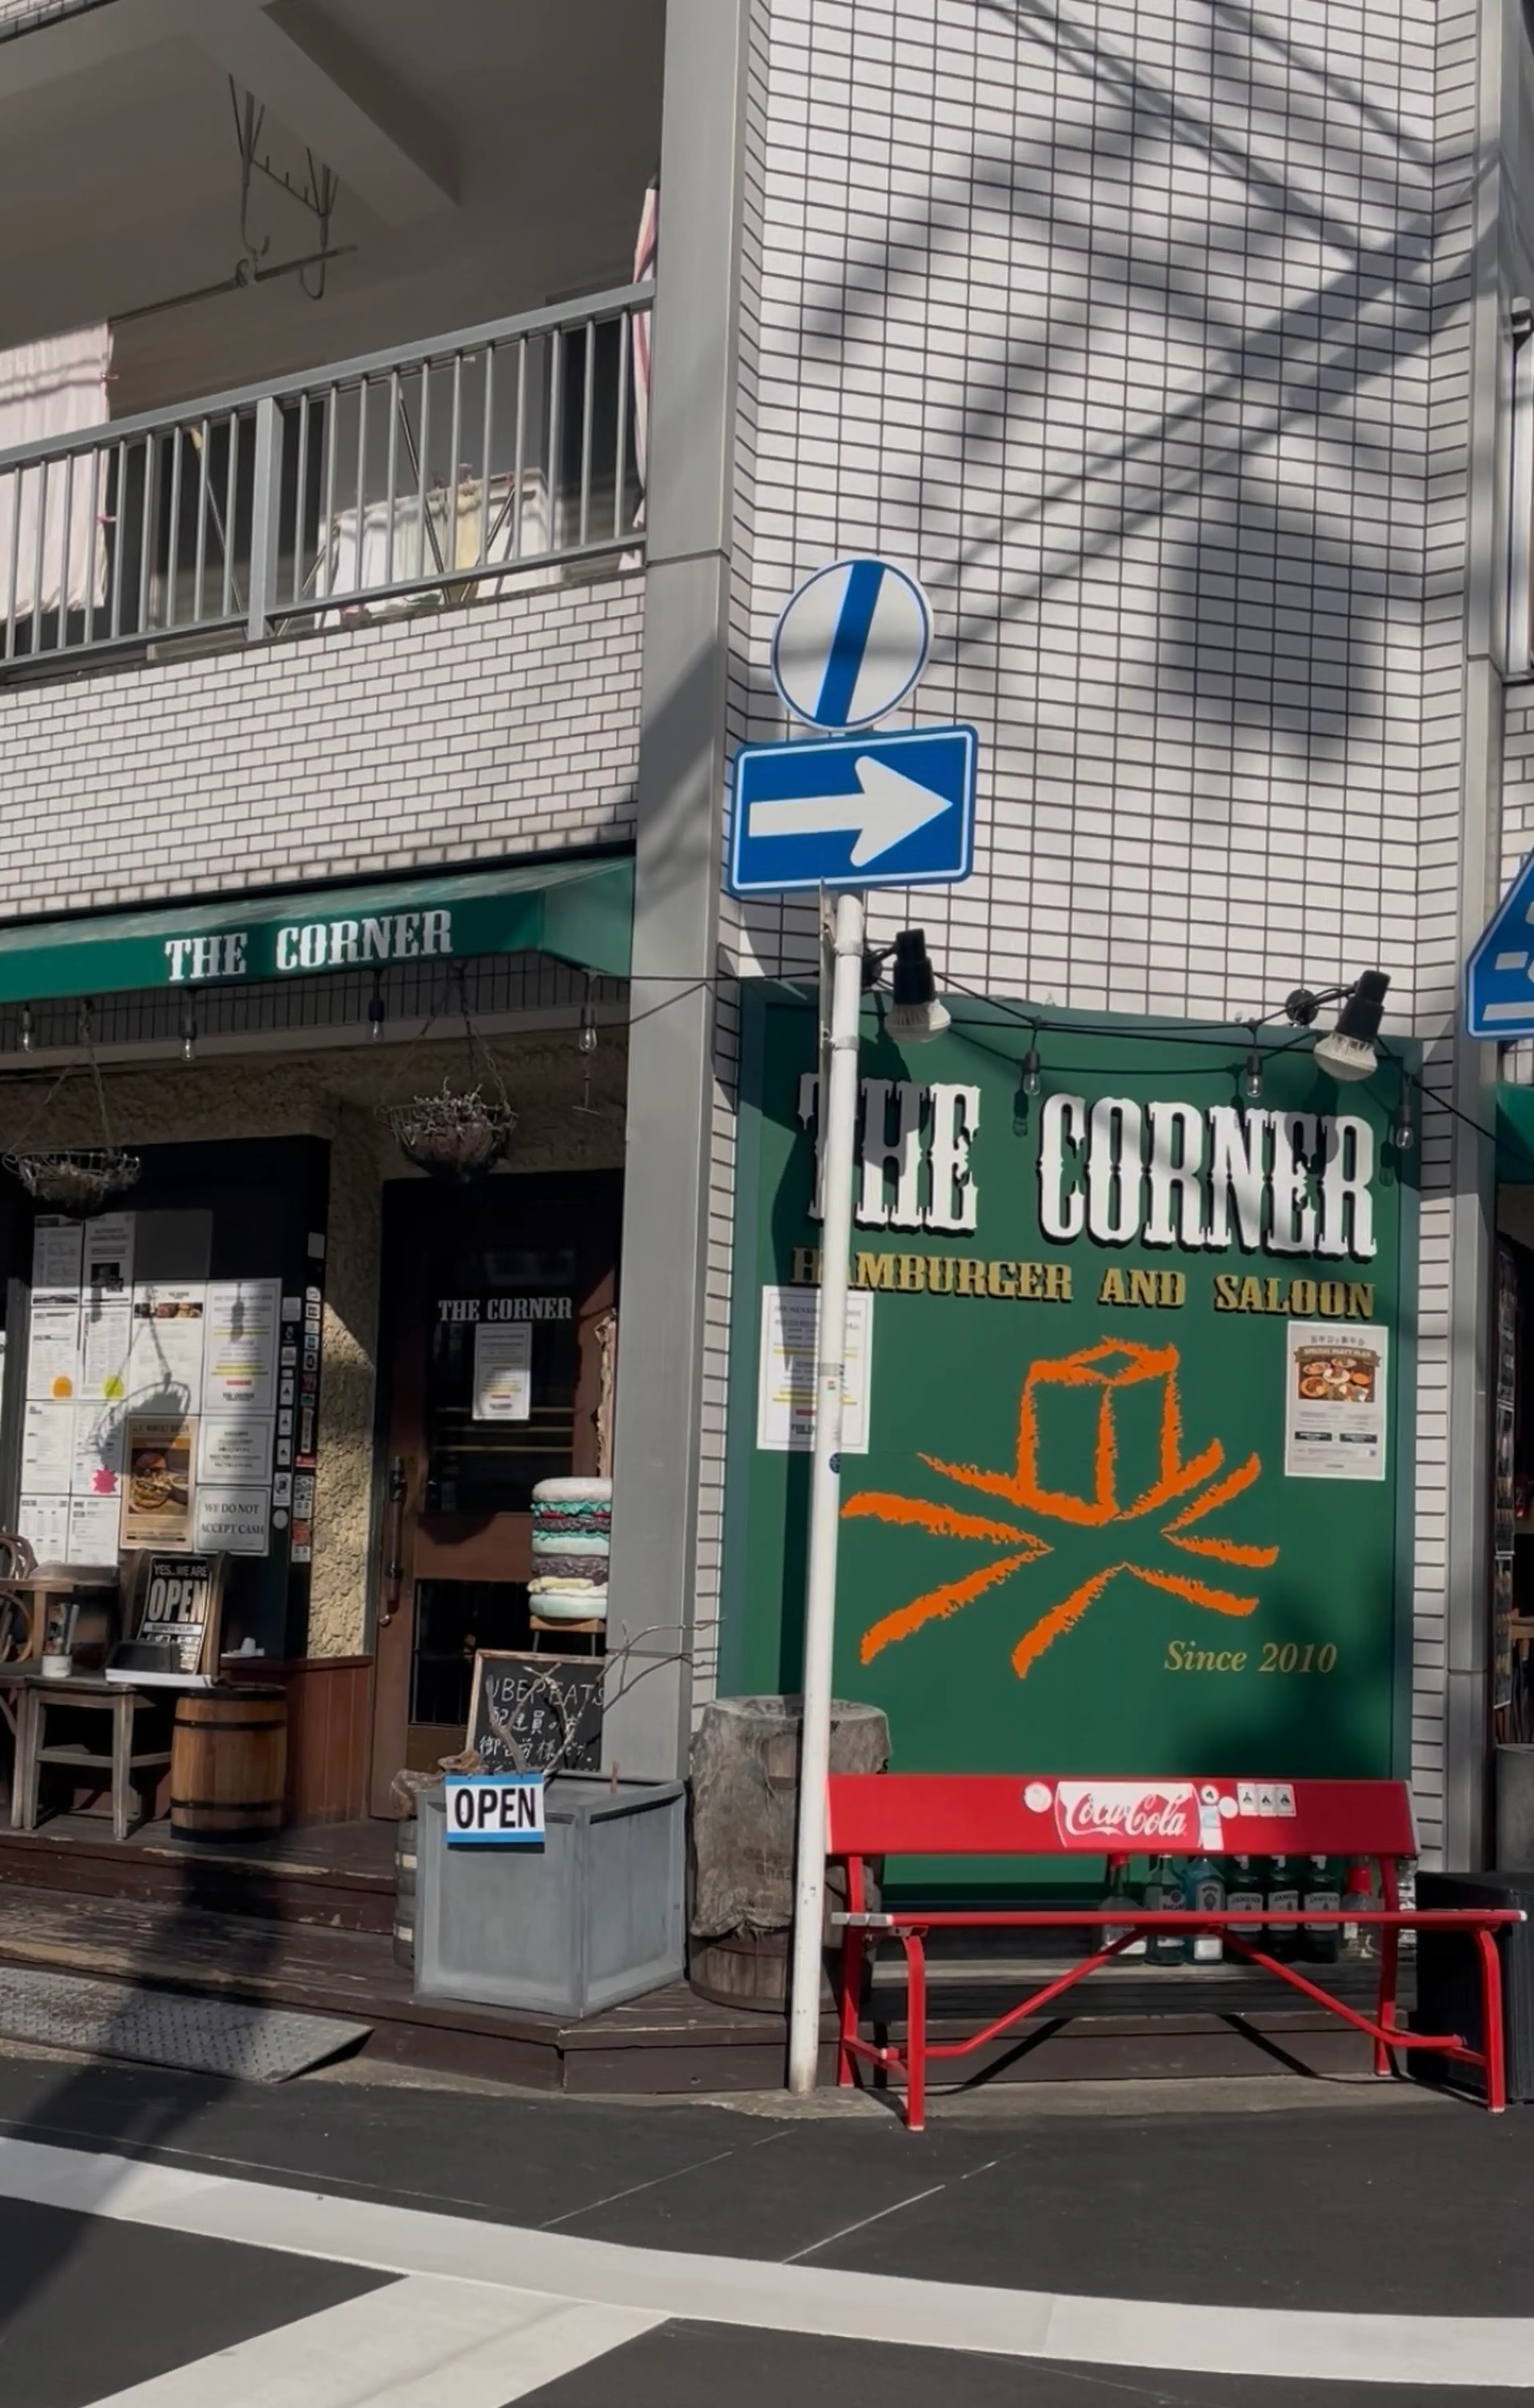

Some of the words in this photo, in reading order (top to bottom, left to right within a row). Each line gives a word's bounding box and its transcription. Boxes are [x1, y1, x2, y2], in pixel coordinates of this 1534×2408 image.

[164, 932, 248, 982] THE
[275, 909, 453, 971] CORNER
[1040, 1093, 1377, 1257] CORNER
[790, 1246, 1073, 1302] HMBURGER
[1099, 1268, 1186, 1307] AND
[1216, 1274, 1375, 1317] SALOON
[438, 1299, 481, 1321] THE
[487, 1297, 572, 1319] CORNER
[221, 1503, 237, 1513] DO
[238, 1504, 260, 1514] NOT
[238, 1524, 264, 1535] CASH
[148, 1578, 207, 1622] OPEN
[1163, 1640, 1248, 1672] Since
[1258, 1642, 1337, 1674] 2010
[455, 1787, 536, 1829] OPEN
[1065, 1792, 1188, 1837] Coca-Cola
